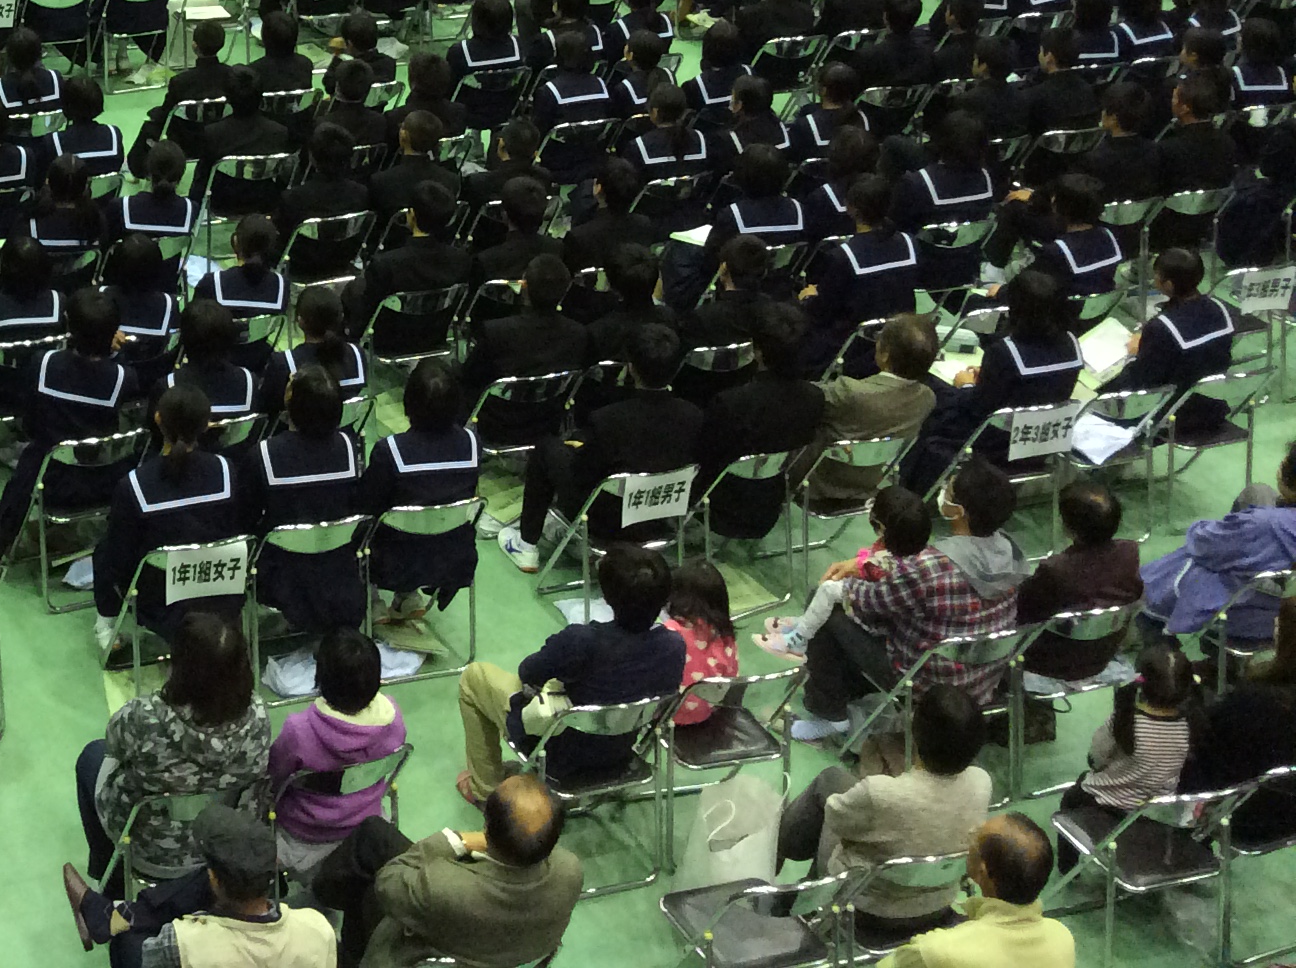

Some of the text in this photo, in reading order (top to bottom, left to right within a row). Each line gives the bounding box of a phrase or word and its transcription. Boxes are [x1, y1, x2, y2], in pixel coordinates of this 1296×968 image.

[627, 480, 686, 510] 1年1組男子
[171, 557, 242, 586] 1年1組女子
